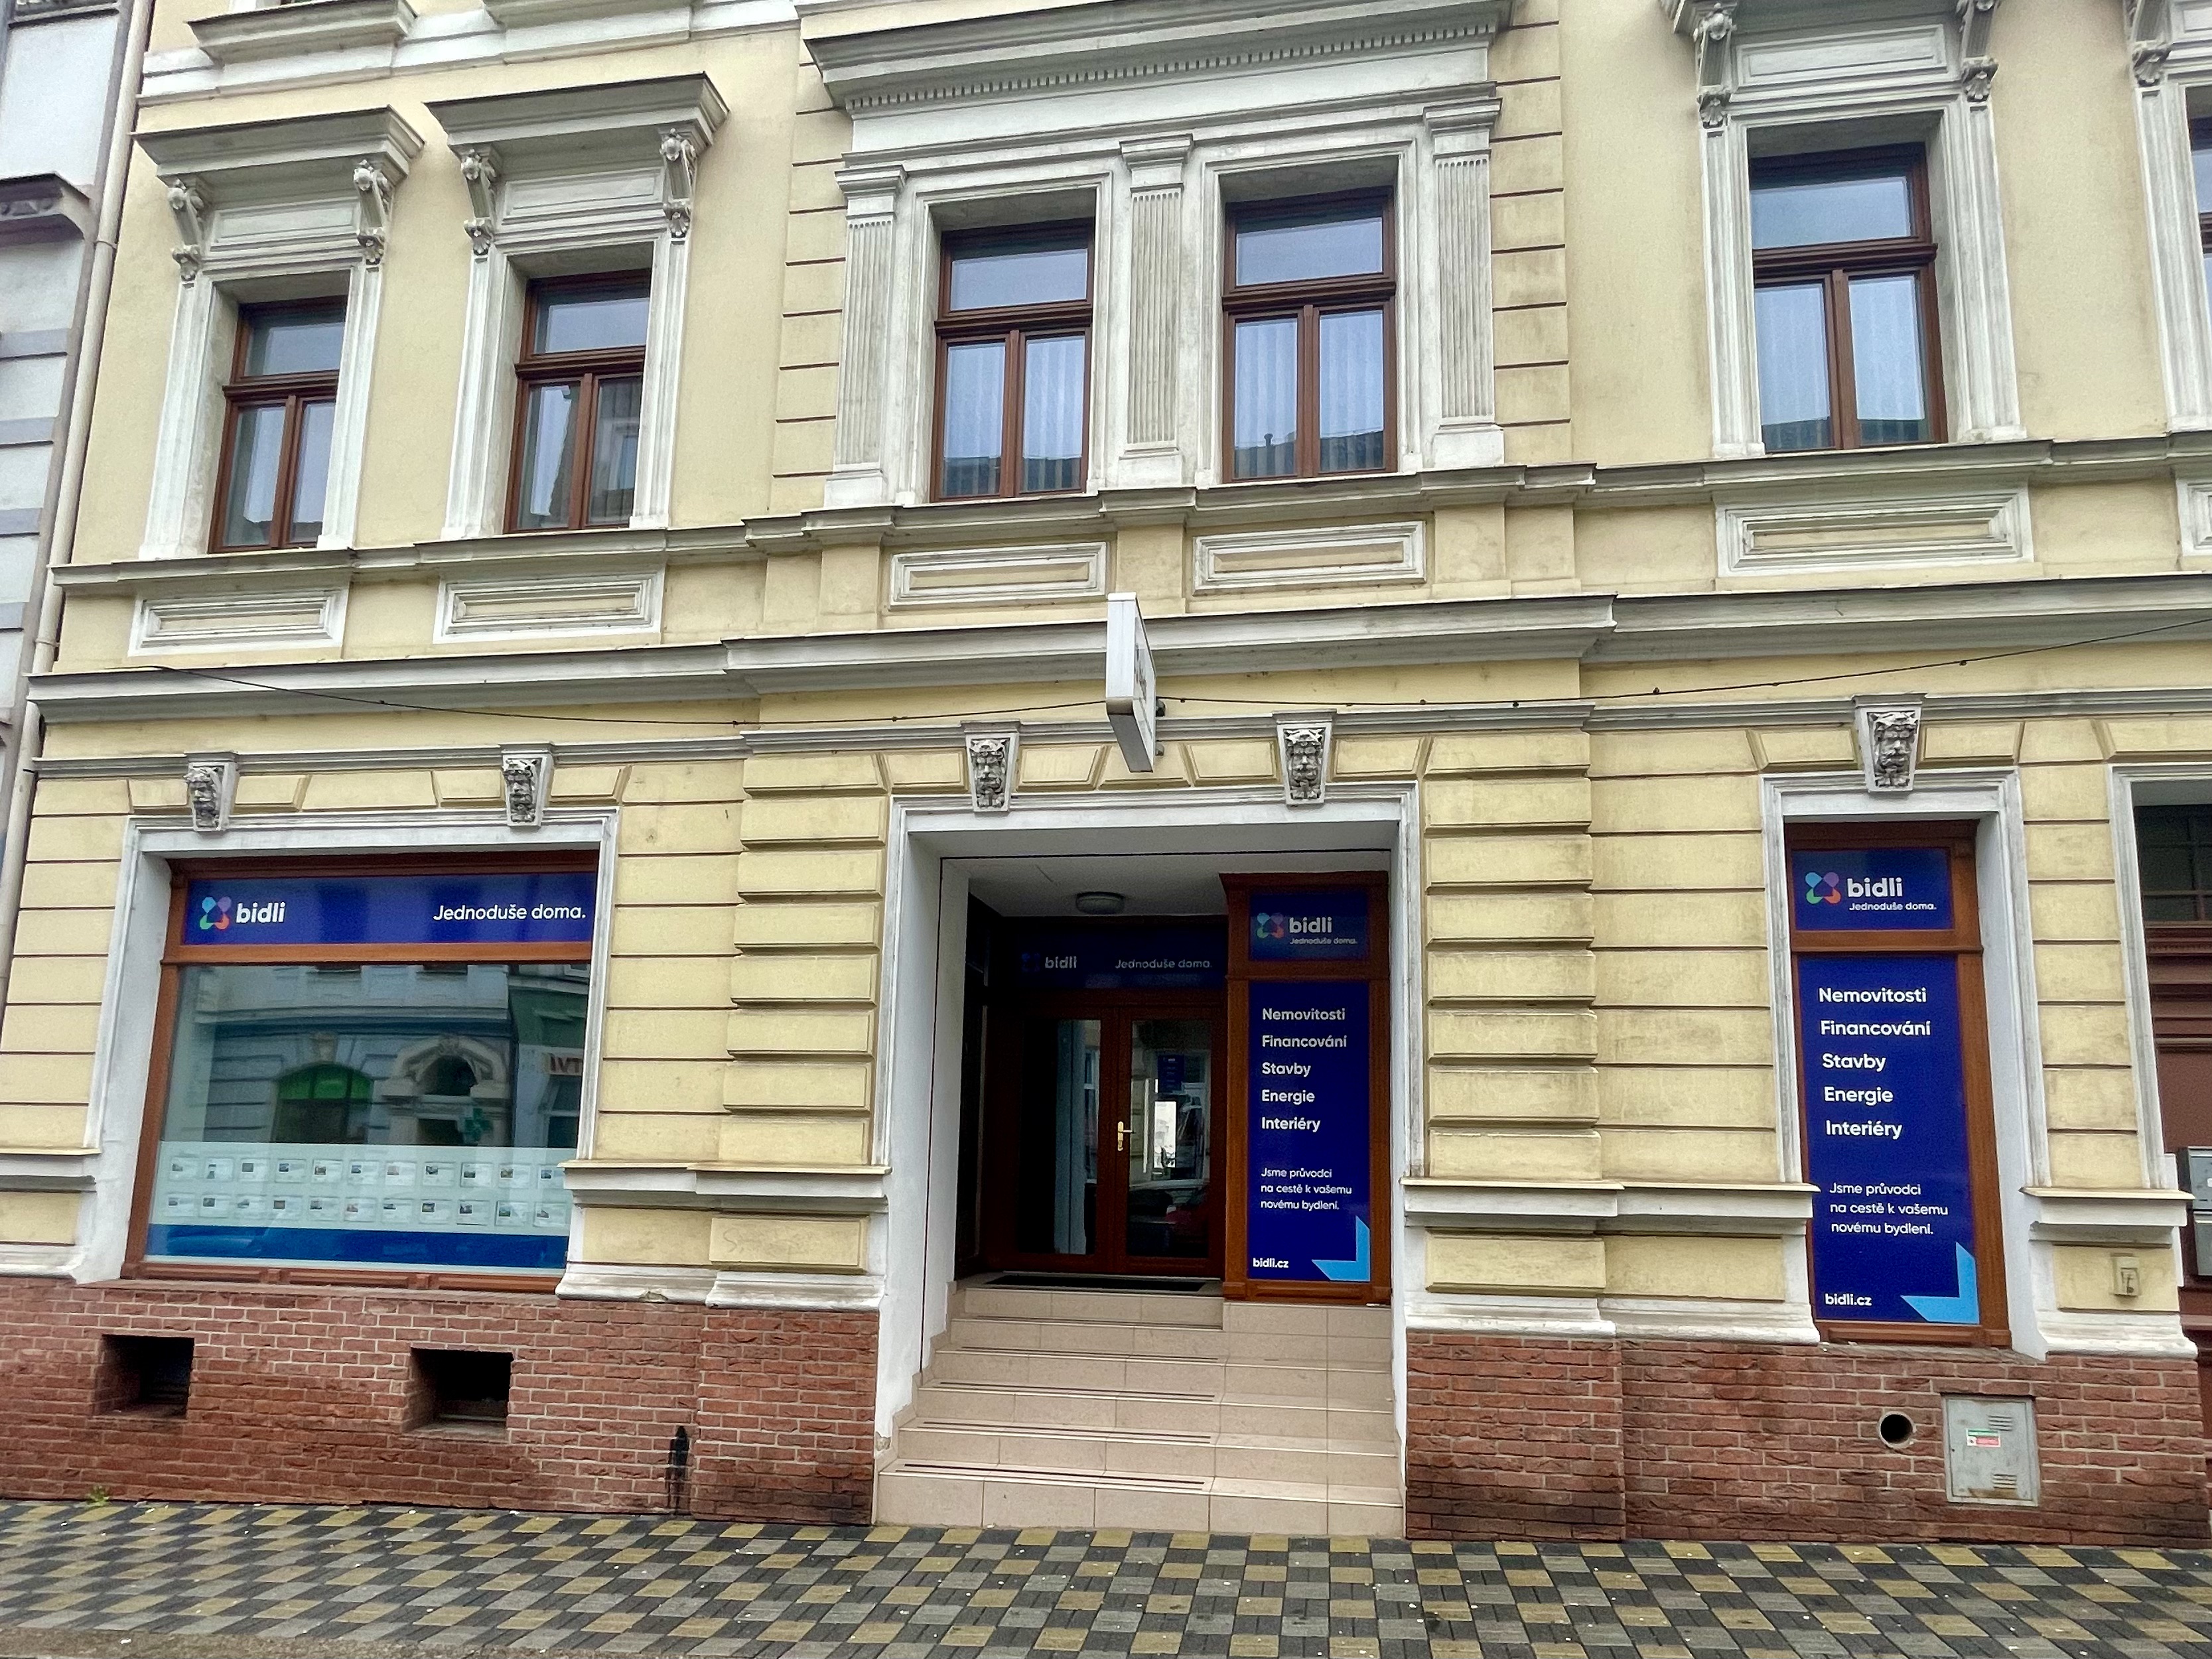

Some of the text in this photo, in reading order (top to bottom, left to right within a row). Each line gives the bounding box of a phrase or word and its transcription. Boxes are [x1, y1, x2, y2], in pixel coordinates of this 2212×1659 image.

[1847, 877, 1903, 897] bidli
[236, 901, 286, 923] bidli
[433, 903, 586, 921] Jednoduše doma.
[1849, 901, 1937, 911] Jednoduše doma.
[1289, 916, 1332, 933] bidli
[1044, 955, 1077, 968] bidli
[1115, 959, 1176, 969] Jednoduše
[1819, 986, 1927, 1003] Nemovitosti
[1262, 1008, 1346, 1020] Nemovitosti
[1821, 1020, 1931, 1036] Financování
[1262, 1034, 1348, 1047] Financování
[1262, 1061, 1311, 1077] Stavby
[1822, 1053, 1886, 1073] Stavby
[1261, 1089, 1315, 1105] Energie
[1824, 1086, 1894, 1106] Energie
[1261, 1116, 1321, 1133] Interiéry
[1826, 1120, 1903, 1140] Interiéry
[1261, 1167, 1332, 1179] Jsme průvodci
[1276, 1183, 1303, 1193] cestě
[1305, 1184, 1311, 1193] k
[1313, 1184, 1352, 1195] vašemu
[1829, 1182, 1921, 1197] Jsme průvodci
[1261, 1199, 1300, 1209] novému
[1830, 1202, 1949, 1215] na cestě k vašemu
[1831, 1222, 1882, 1234] novému
[1253, 1257, 1289, 1268] bidli.cz
[1825, 1293, 1872, 1306] bidli.cz
